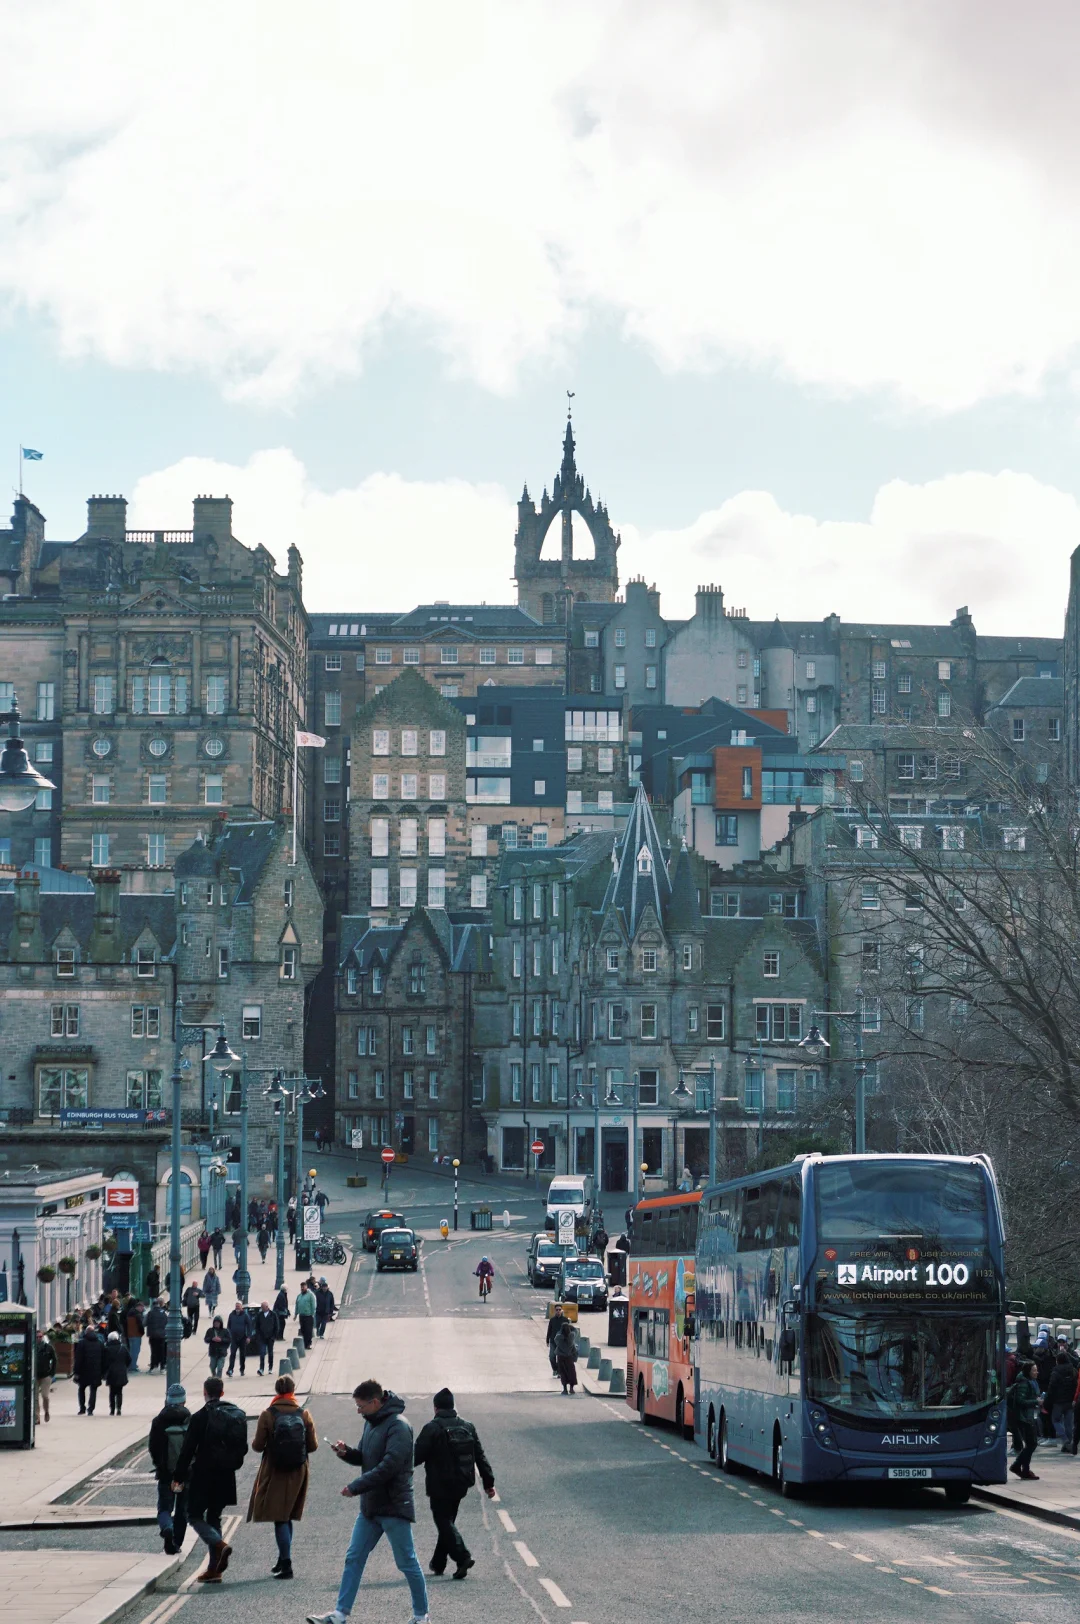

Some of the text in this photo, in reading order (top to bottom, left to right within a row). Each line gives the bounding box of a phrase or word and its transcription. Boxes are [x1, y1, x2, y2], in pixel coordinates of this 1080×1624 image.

[861, 1263, 969, 1286] Airport 100
[975, 1269, 993, 1278] 1132
[823, 1291, 987, 1300] www.lothianbuses.co.uk/airlink
[881, 1435, 940, 1445] AIRLINK
[892, 1469, 910, 1477] SB19
